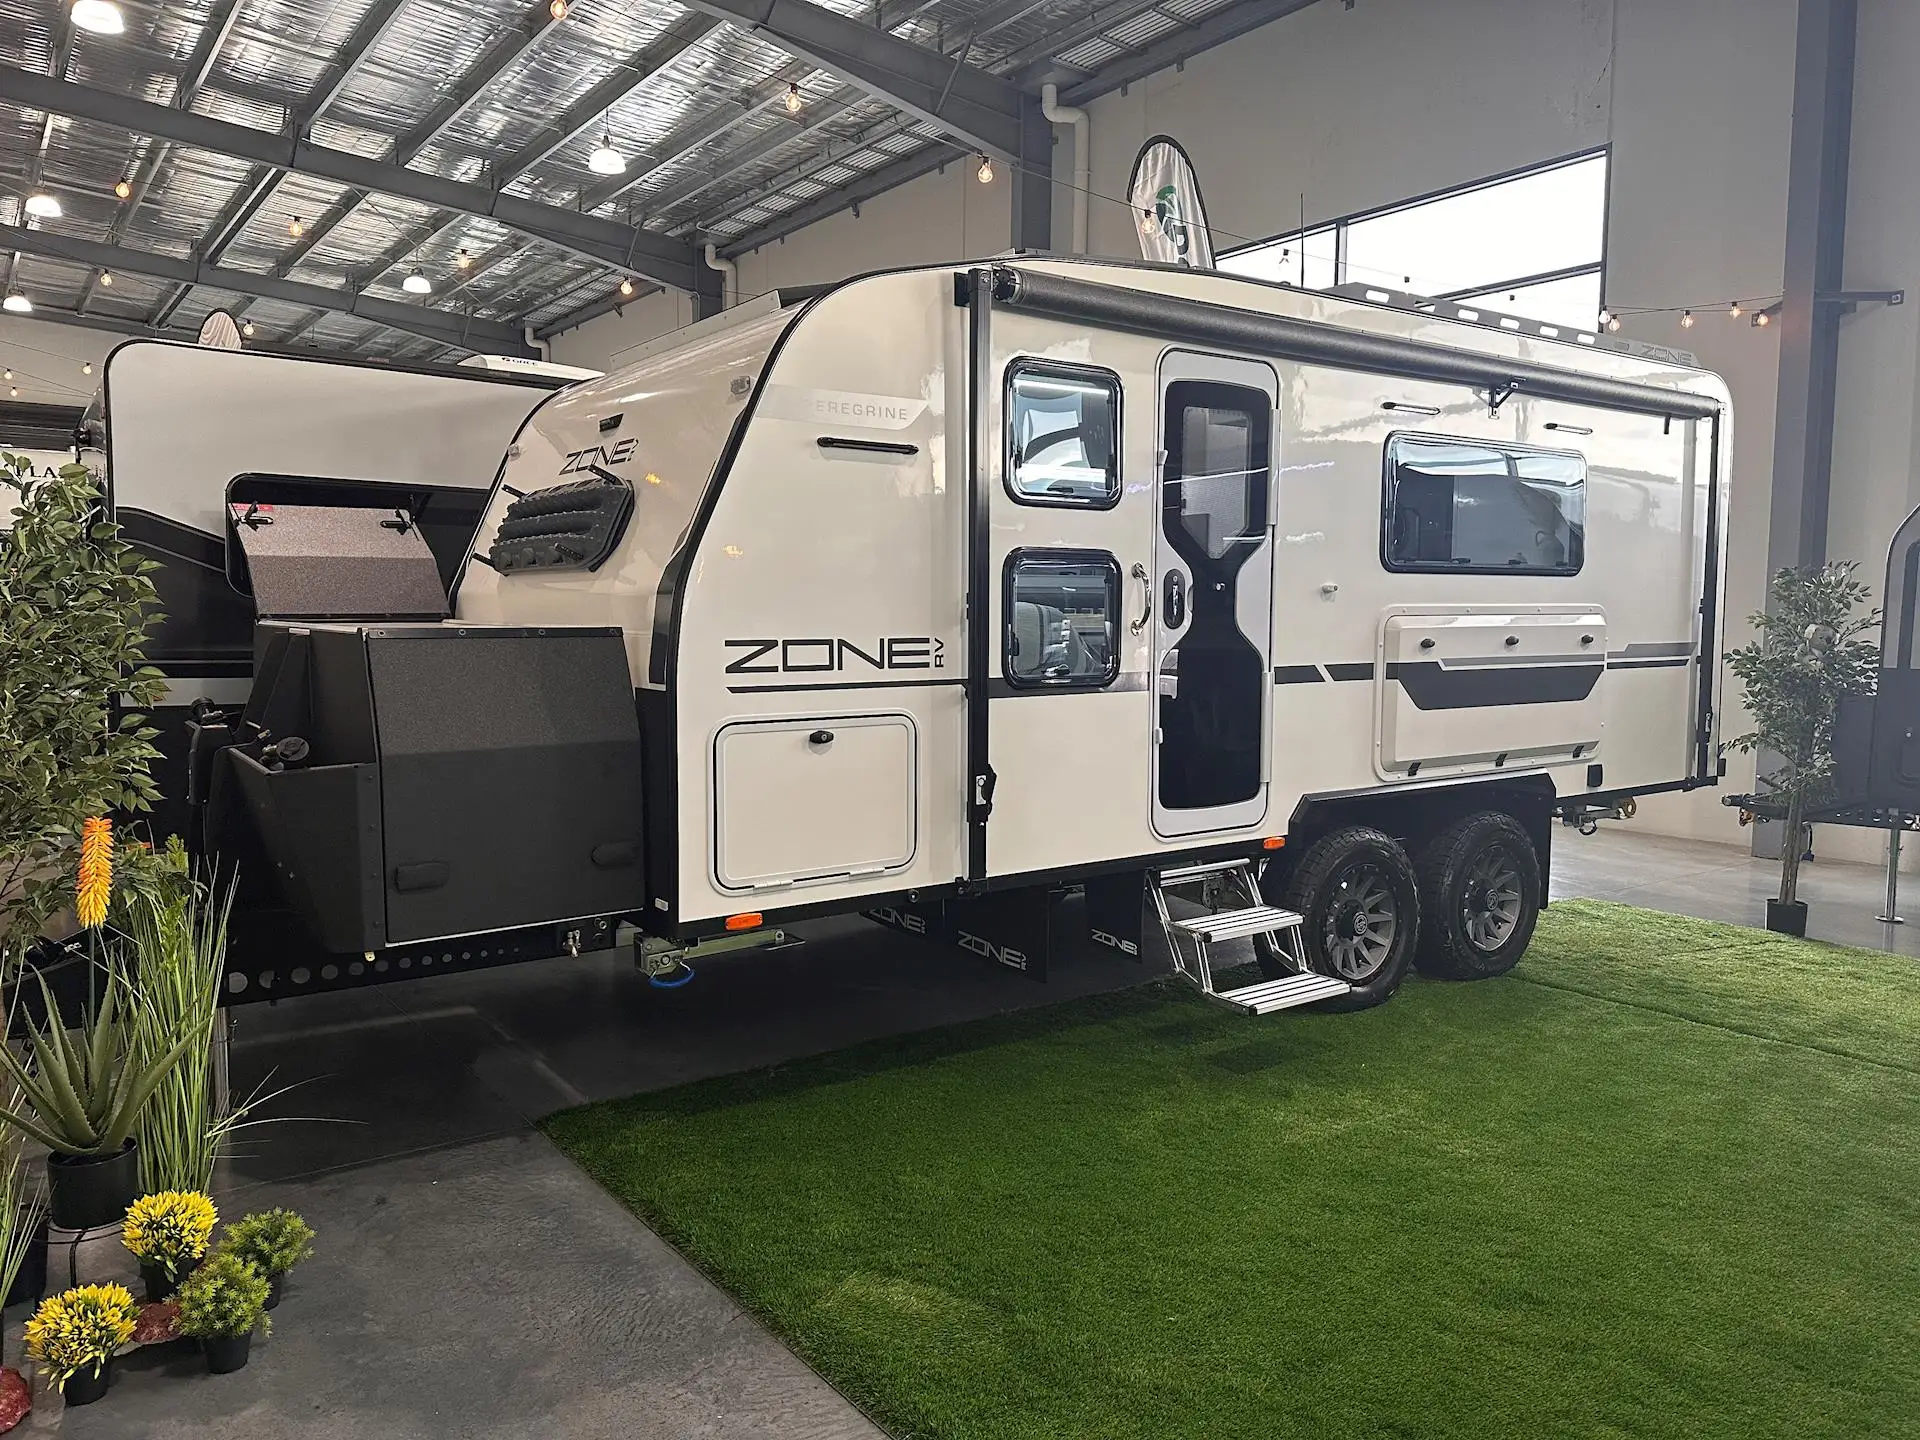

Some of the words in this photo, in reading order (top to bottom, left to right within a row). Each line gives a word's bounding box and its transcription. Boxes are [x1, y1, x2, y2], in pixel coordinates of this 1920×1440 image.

[1640, 343, 1692, 366] ZONE
[803, 398, 908, 420] EREGRINE
[558, 438, 635, 476] ZONE
[724, 637, 931, 674] ZONE
[934, 637, 945, 668] RV
[869, 907, 921, 933] ZONE
[957, 930, 1021, 969] ZONE
[1091, 928, 1134, 954] ZONE
